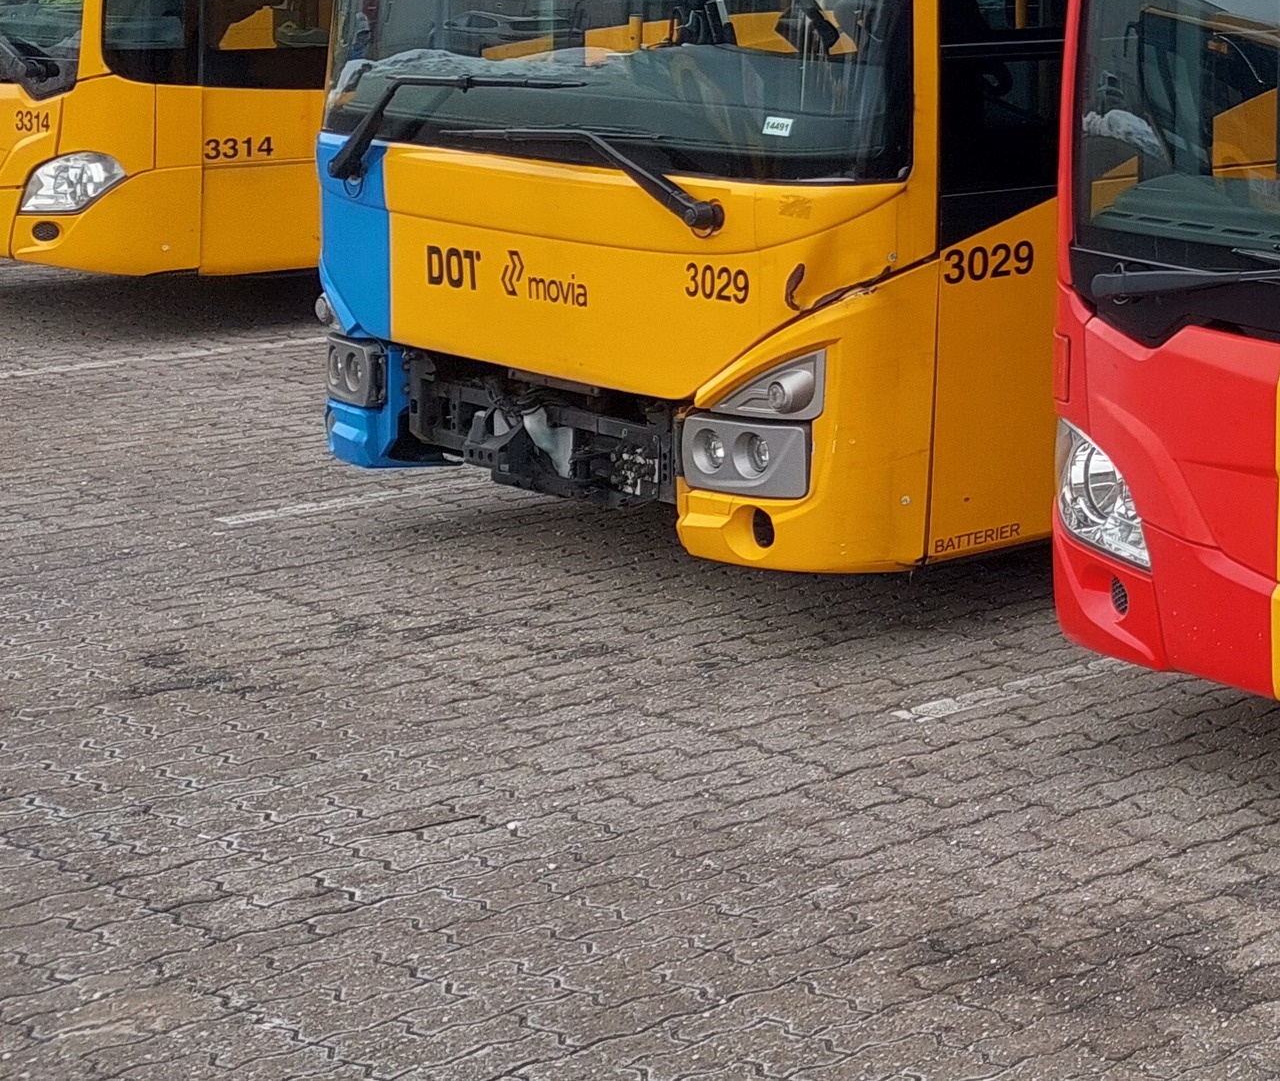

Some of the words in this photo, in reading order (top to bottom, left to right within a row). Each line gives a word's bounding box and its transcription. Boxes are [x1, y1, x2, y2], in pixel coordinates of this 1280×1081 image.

[15, 110, 50, 132] 3314
[204, 136, 274, 160] 3314
[426, 245, 481, 291] DOT
[943, 240, 1034, 284] 3029
[528, 274, 588, 307] movia
[684, 262, 750, 304] 3029
[934, 522, 1020, 554] BATTERIER
